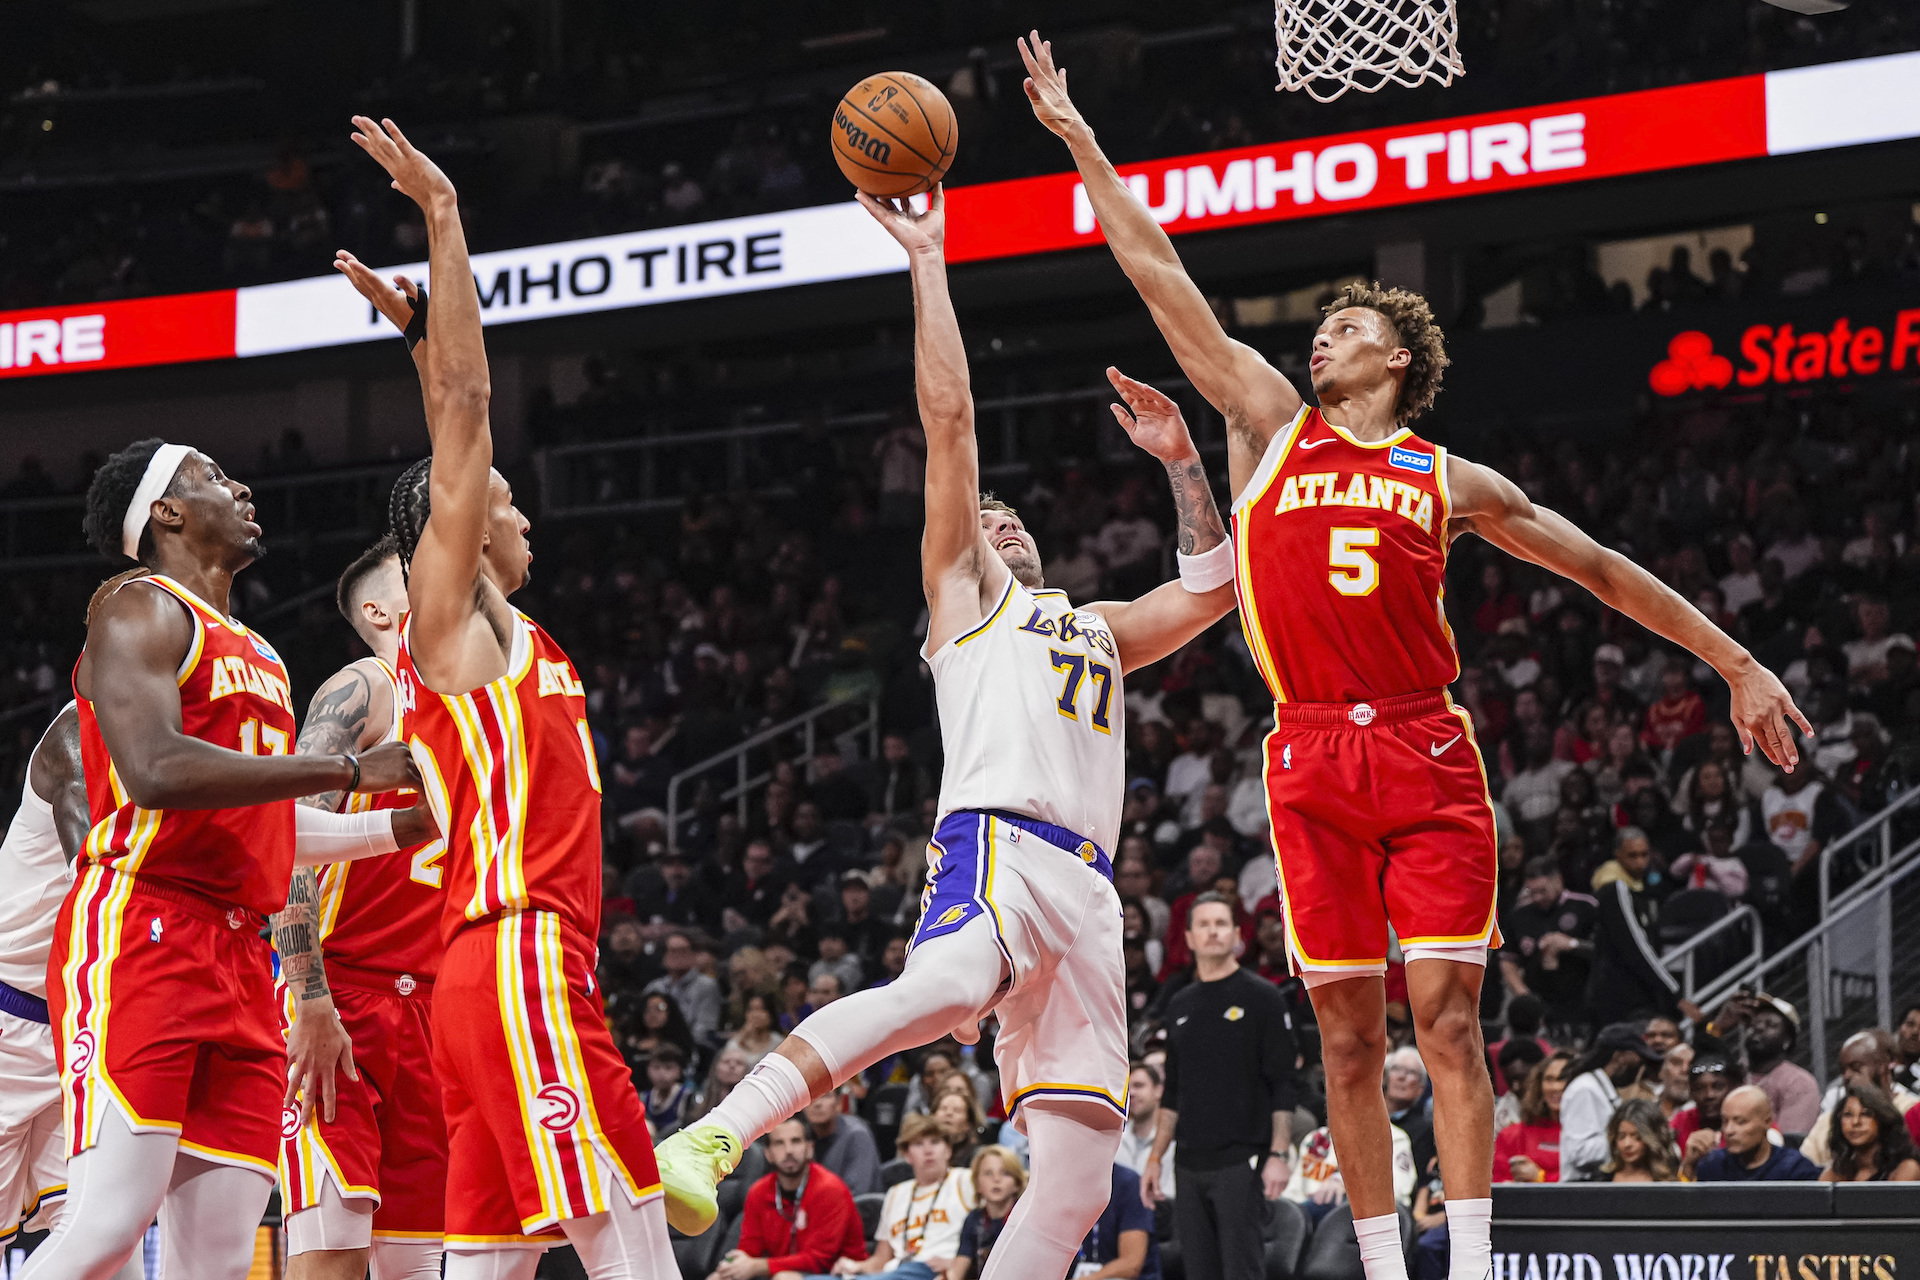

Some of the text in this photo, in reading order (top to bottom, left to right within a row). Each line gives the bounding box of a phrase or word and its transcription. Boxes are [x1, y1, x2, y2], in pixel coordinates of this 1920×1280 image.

[835, 106, 892, 166] Wilson
[1385, 112, 1587, 190] TIRE
[626, 231, 782, 289] TIRE
[0, 314, 106, 369] IRE
[1737, 307, 1920, 387] State F
[1392, 451, 1430, 467] paze
[1275, 472, 1434, 536] ATLANTA
[1328, 526, 1381, 597] 5
[209, 655, 295, 721] ATLANT
[1049, 647, 1115, 736] 77
[1348, 709, 1377, 721] HAWKS
[1493, 1253, 1898, 1280] HARD WORK TASTES
